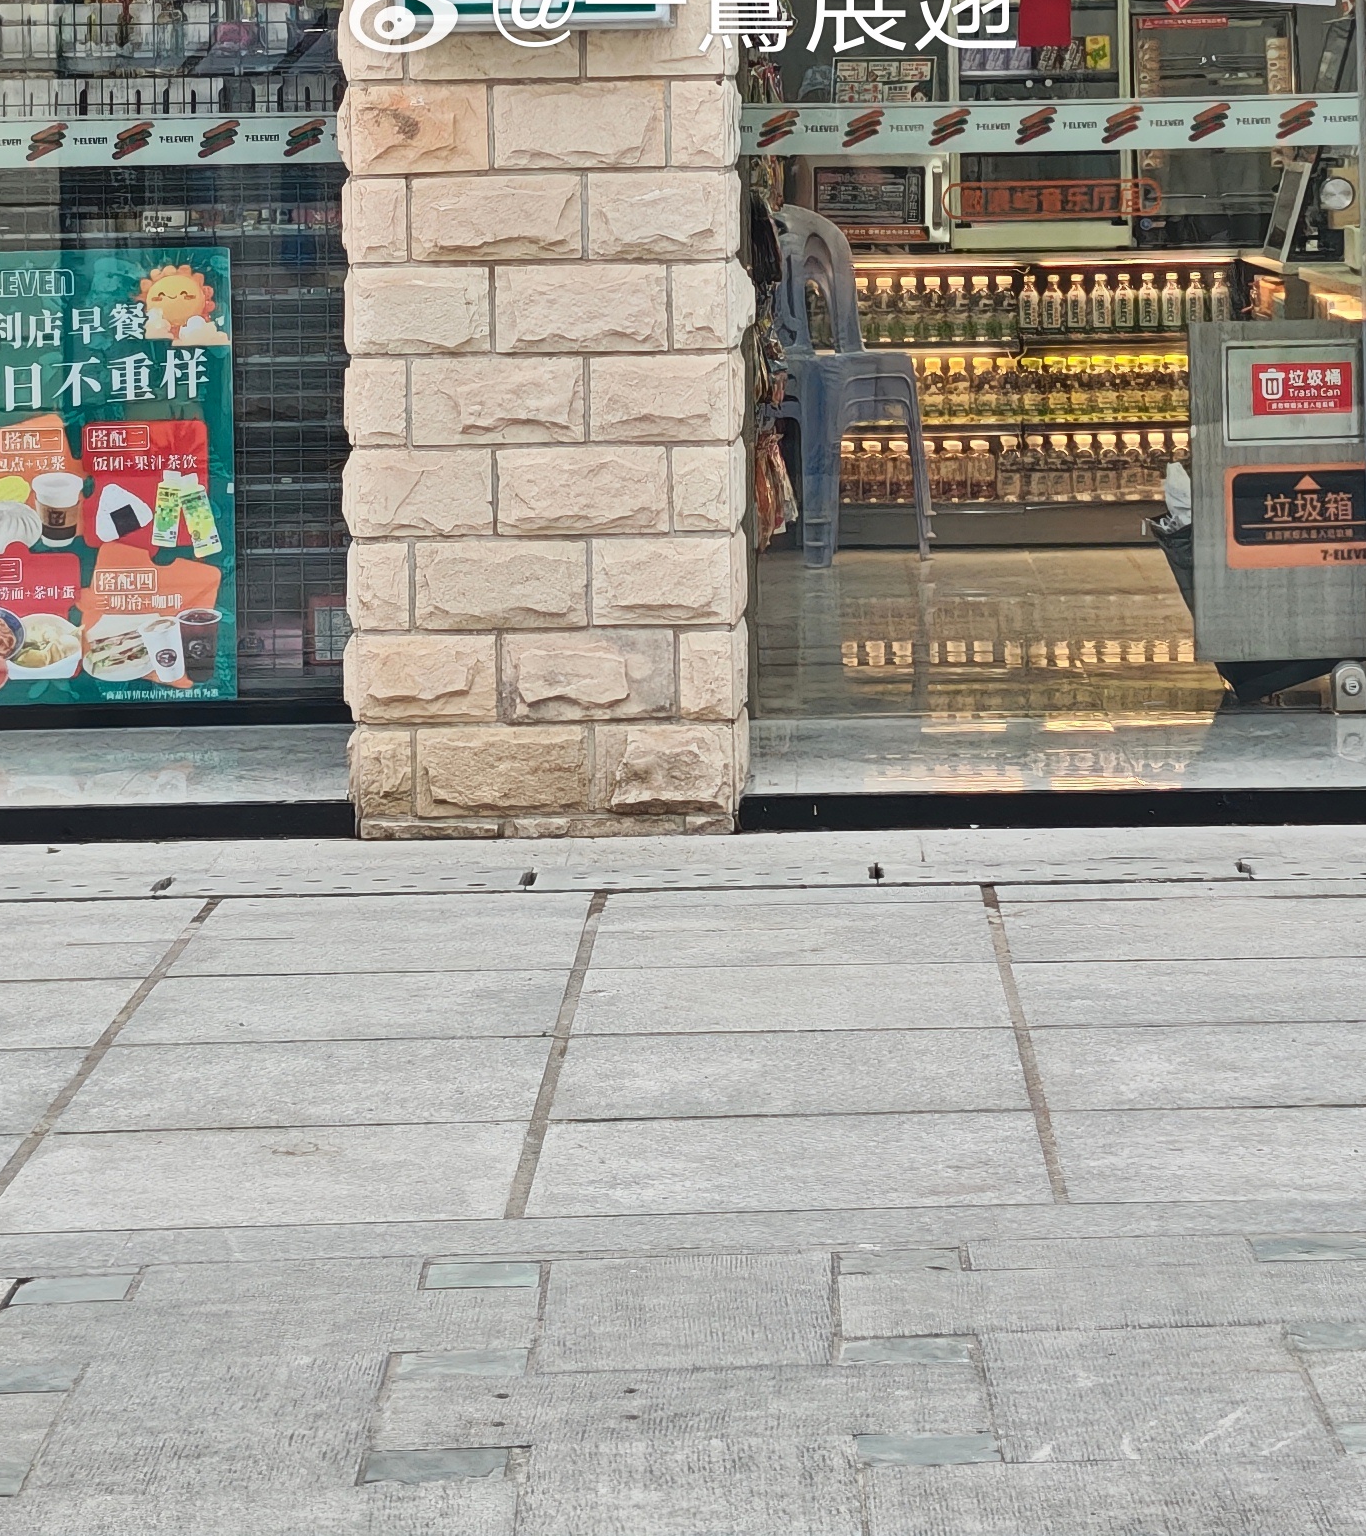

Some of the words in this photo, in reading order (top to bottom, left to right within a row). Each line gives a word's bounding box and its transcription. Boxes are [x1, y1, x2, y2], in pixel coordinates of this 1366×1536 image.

[1288, 368, 1342, 386] 垃圾桶
[1288, 387, 1318, 397] Trash
[1320, 387, 1341, 397] Can
[4, 430, 60, 450] 搭配一
[91, 429, 146, 449] 搭配二
[1264, 492, 1353, 522] 垃圾箱
[98, 572, 154, 591] 搭配四
[96, 593, 183, 611] 三明治+咖啡
